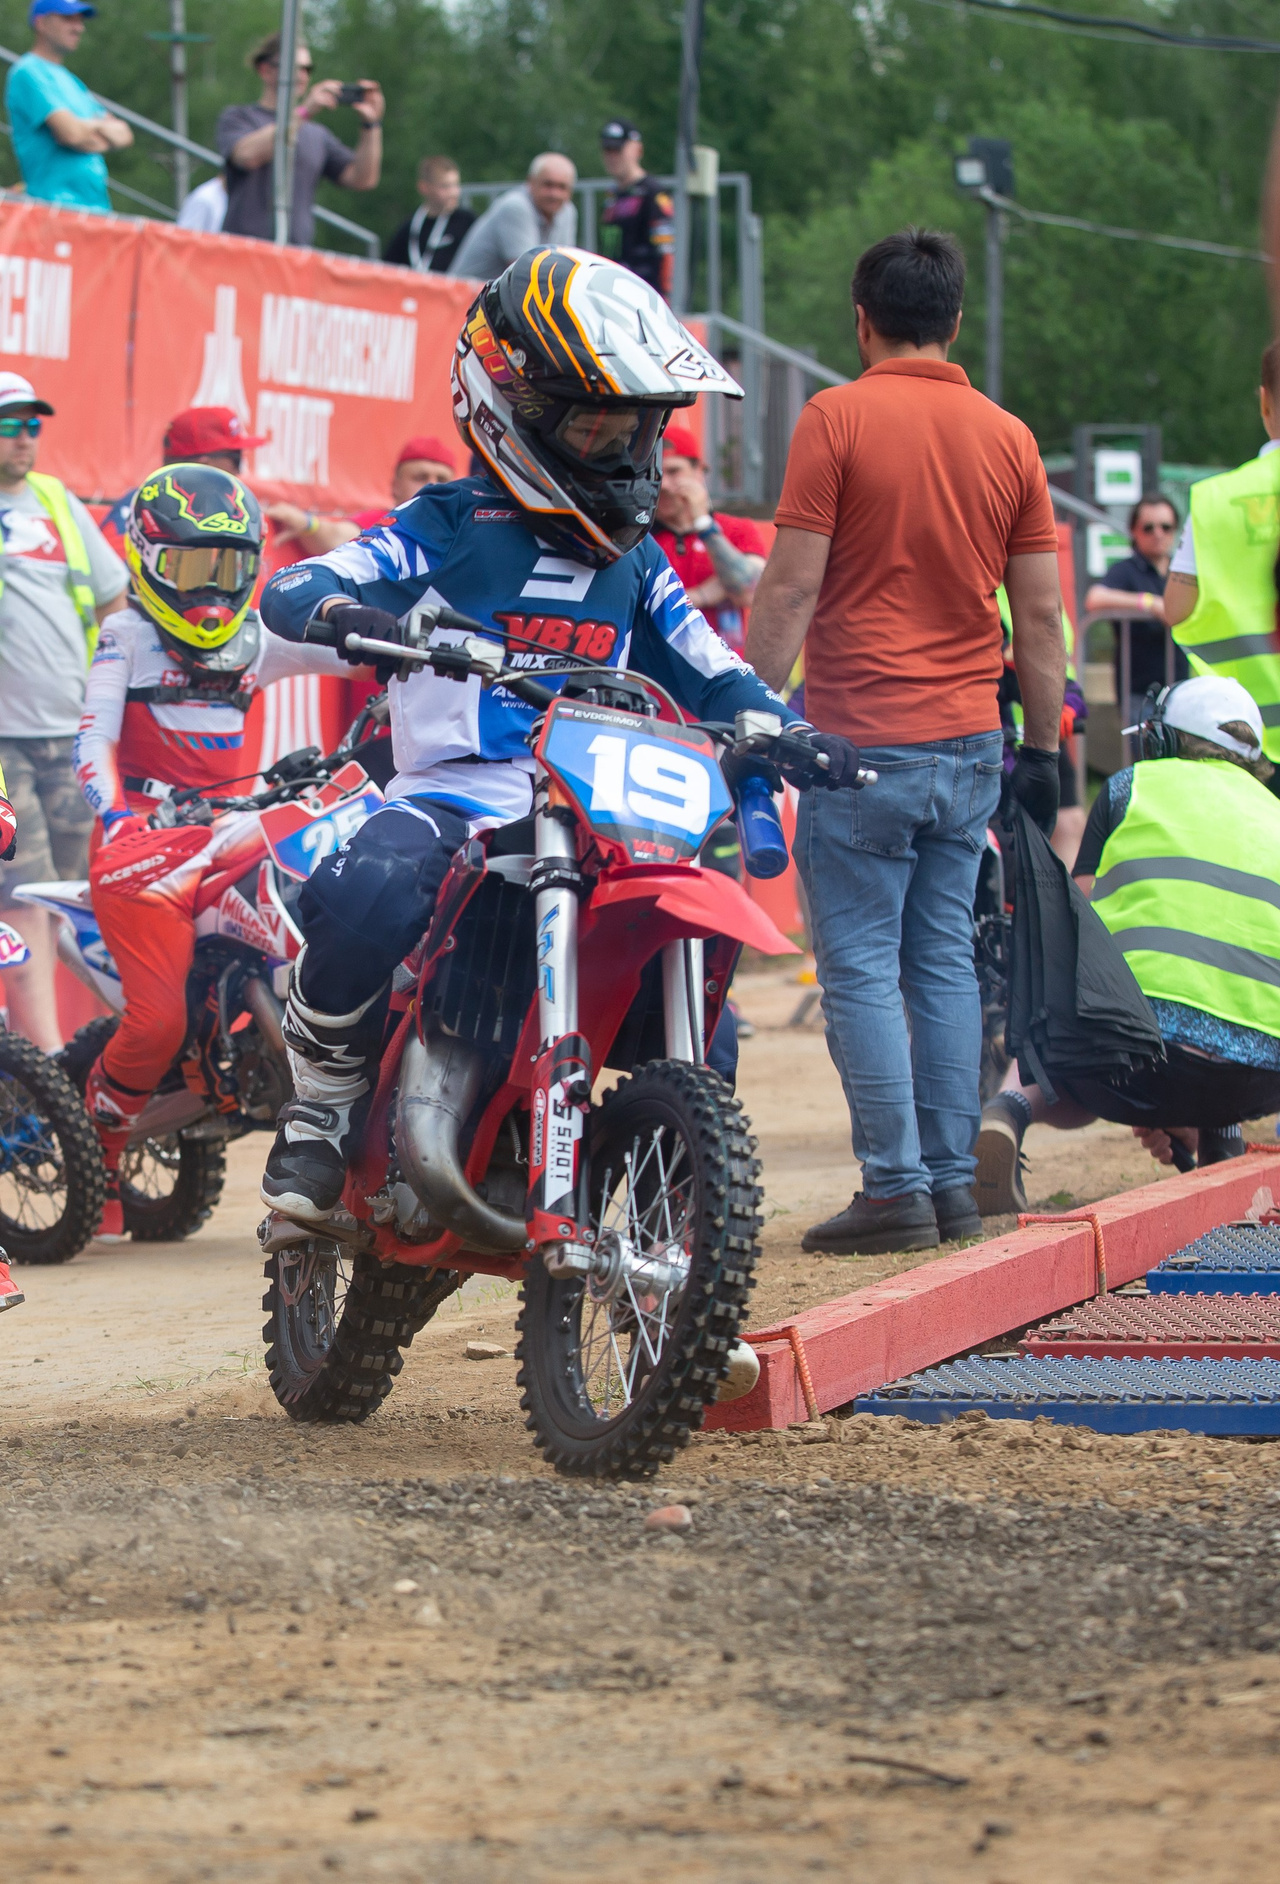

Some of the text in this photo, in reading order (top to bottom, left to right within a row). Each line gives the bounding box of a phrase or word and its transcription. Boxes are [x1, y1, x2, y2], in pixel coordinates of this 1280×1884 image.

[254, 390, 334, 487] СПОРТ
[495, 612, 618, 662] VB18
[574, 709, 643, 728] EVDOKIMOV
[587, 734, 711, 835] 19
[99, 854, 167, 886] ACERBIS
[555, 1126, 573, 1183] SHOT
